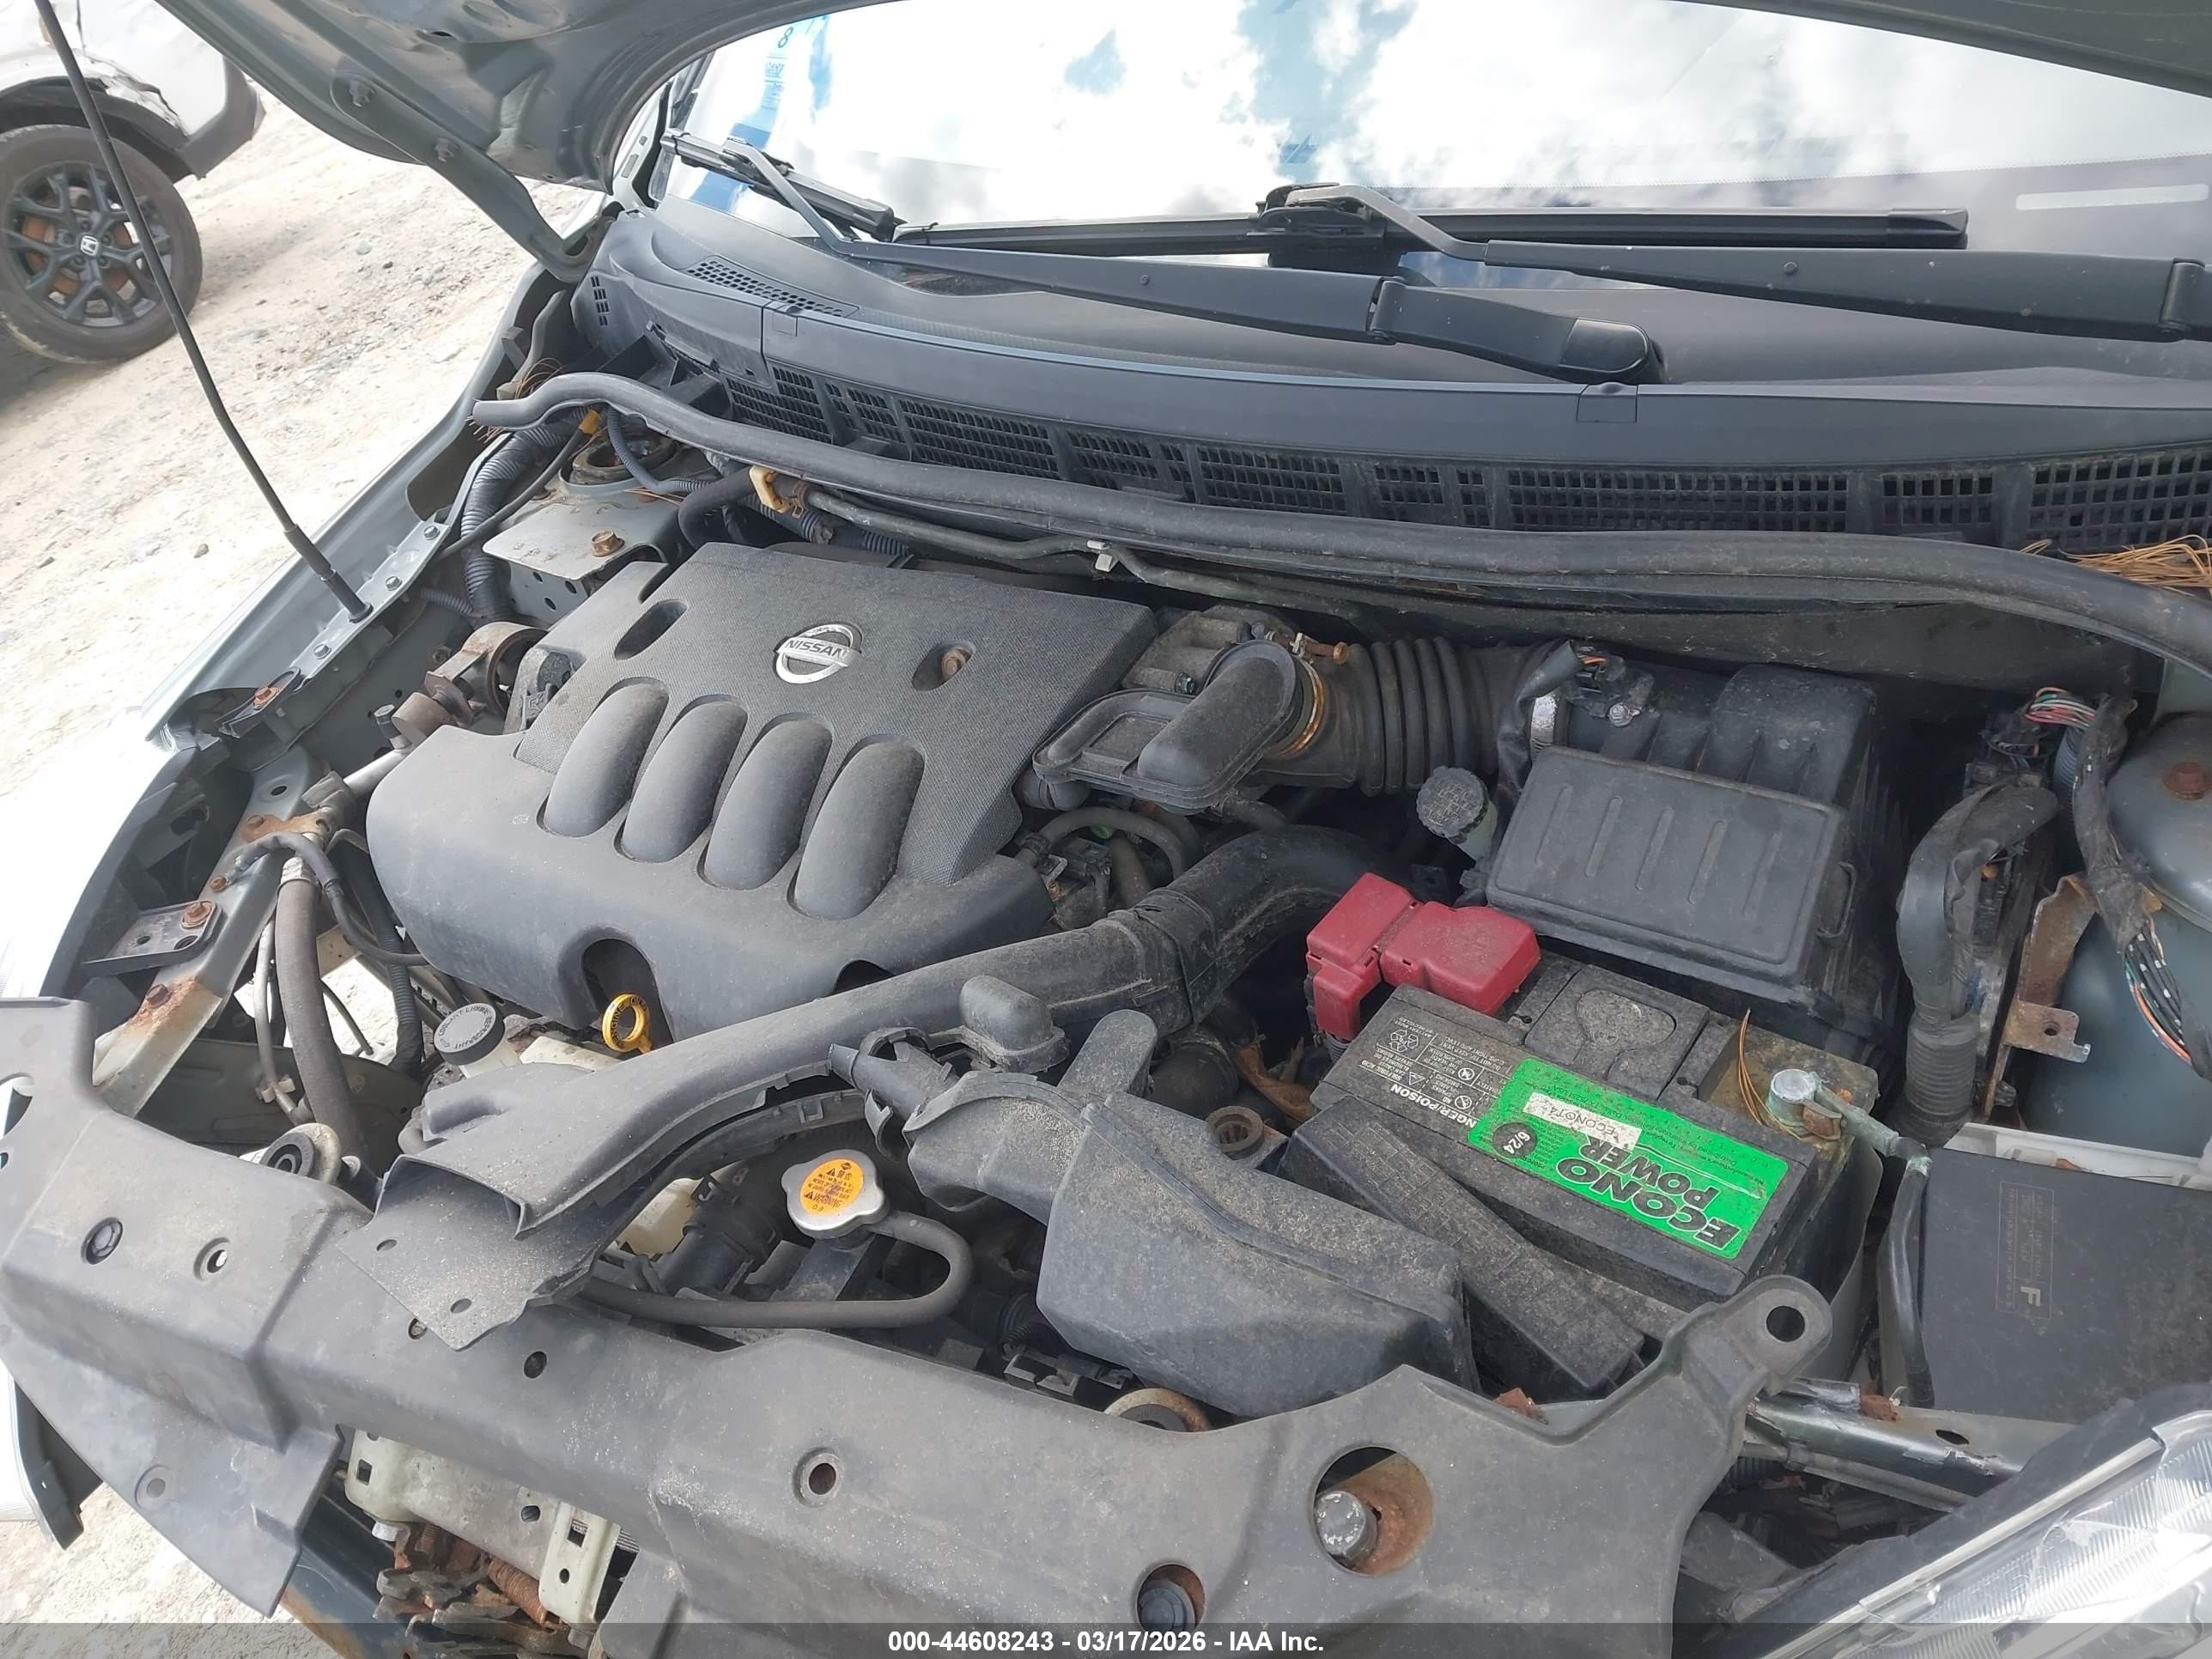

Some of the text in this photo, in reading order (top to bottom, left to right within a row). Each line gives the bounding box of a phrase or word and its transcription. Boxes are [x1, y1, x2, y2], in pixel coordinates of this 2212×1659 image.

[785, 640, 848, 659] NISSAN
[610, 1002, 626, 1046] ENGINE
[1390, 1084, 1476, 1127] NGER/POISON
[1502, 1130, 1532, 1155] 6/24
[1574, 1135, 1721, 1210] POWER
[1552, 1153, 1741, 1249] ECONO
[2021, 1286, 2041, 1307] F
